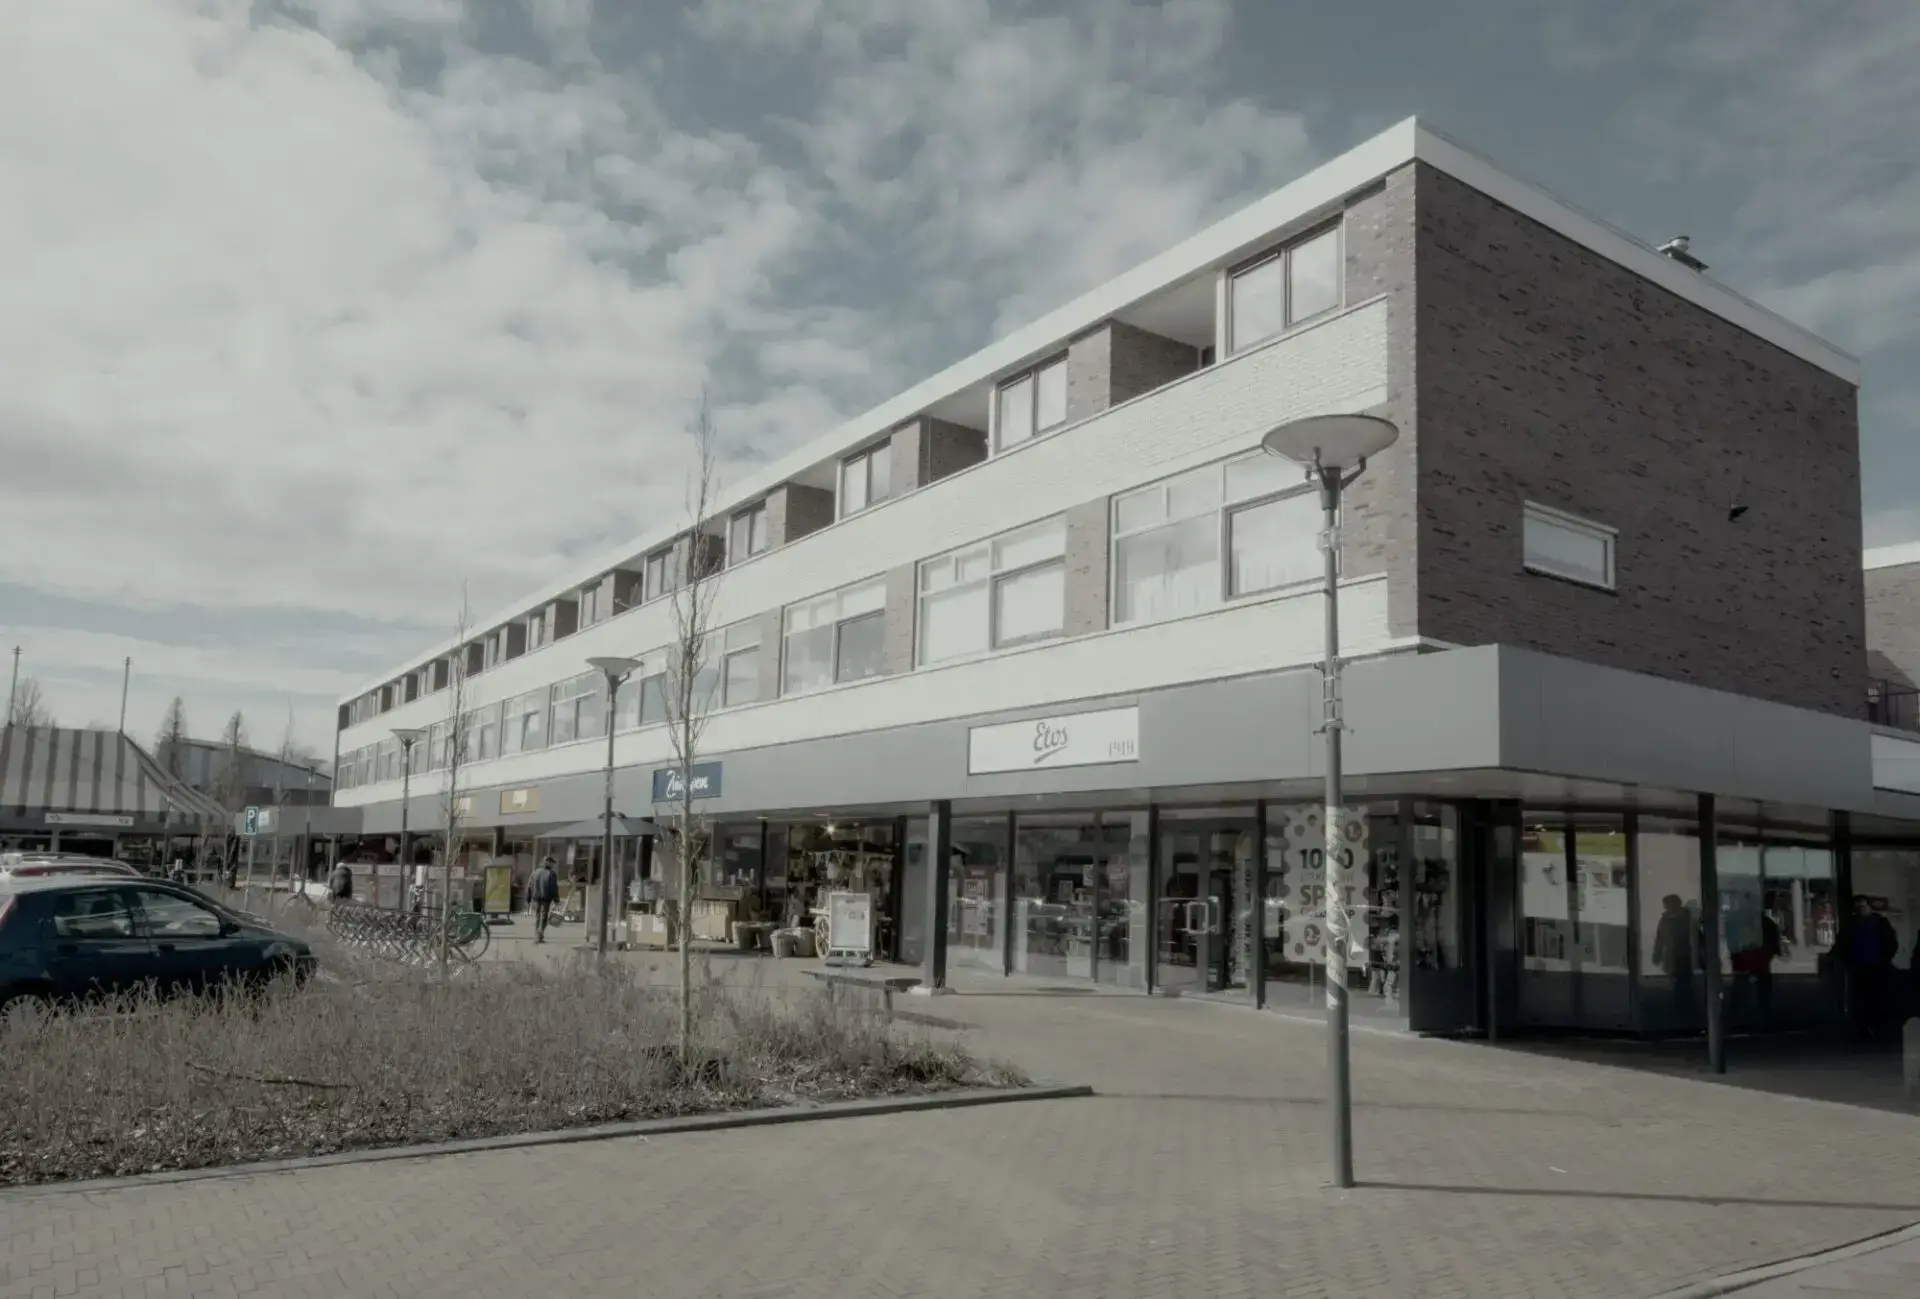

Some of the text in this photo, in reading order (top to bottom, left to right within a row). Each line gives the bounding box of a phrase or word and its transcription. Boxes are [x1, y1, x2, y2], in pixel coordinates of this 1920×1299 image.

[1033, 721, 1068, 752] Etos
[247, 809, 256, 823] P
[1300, 847, 1354, 870] 100
[1300, 884, 1356, 907] SPT
